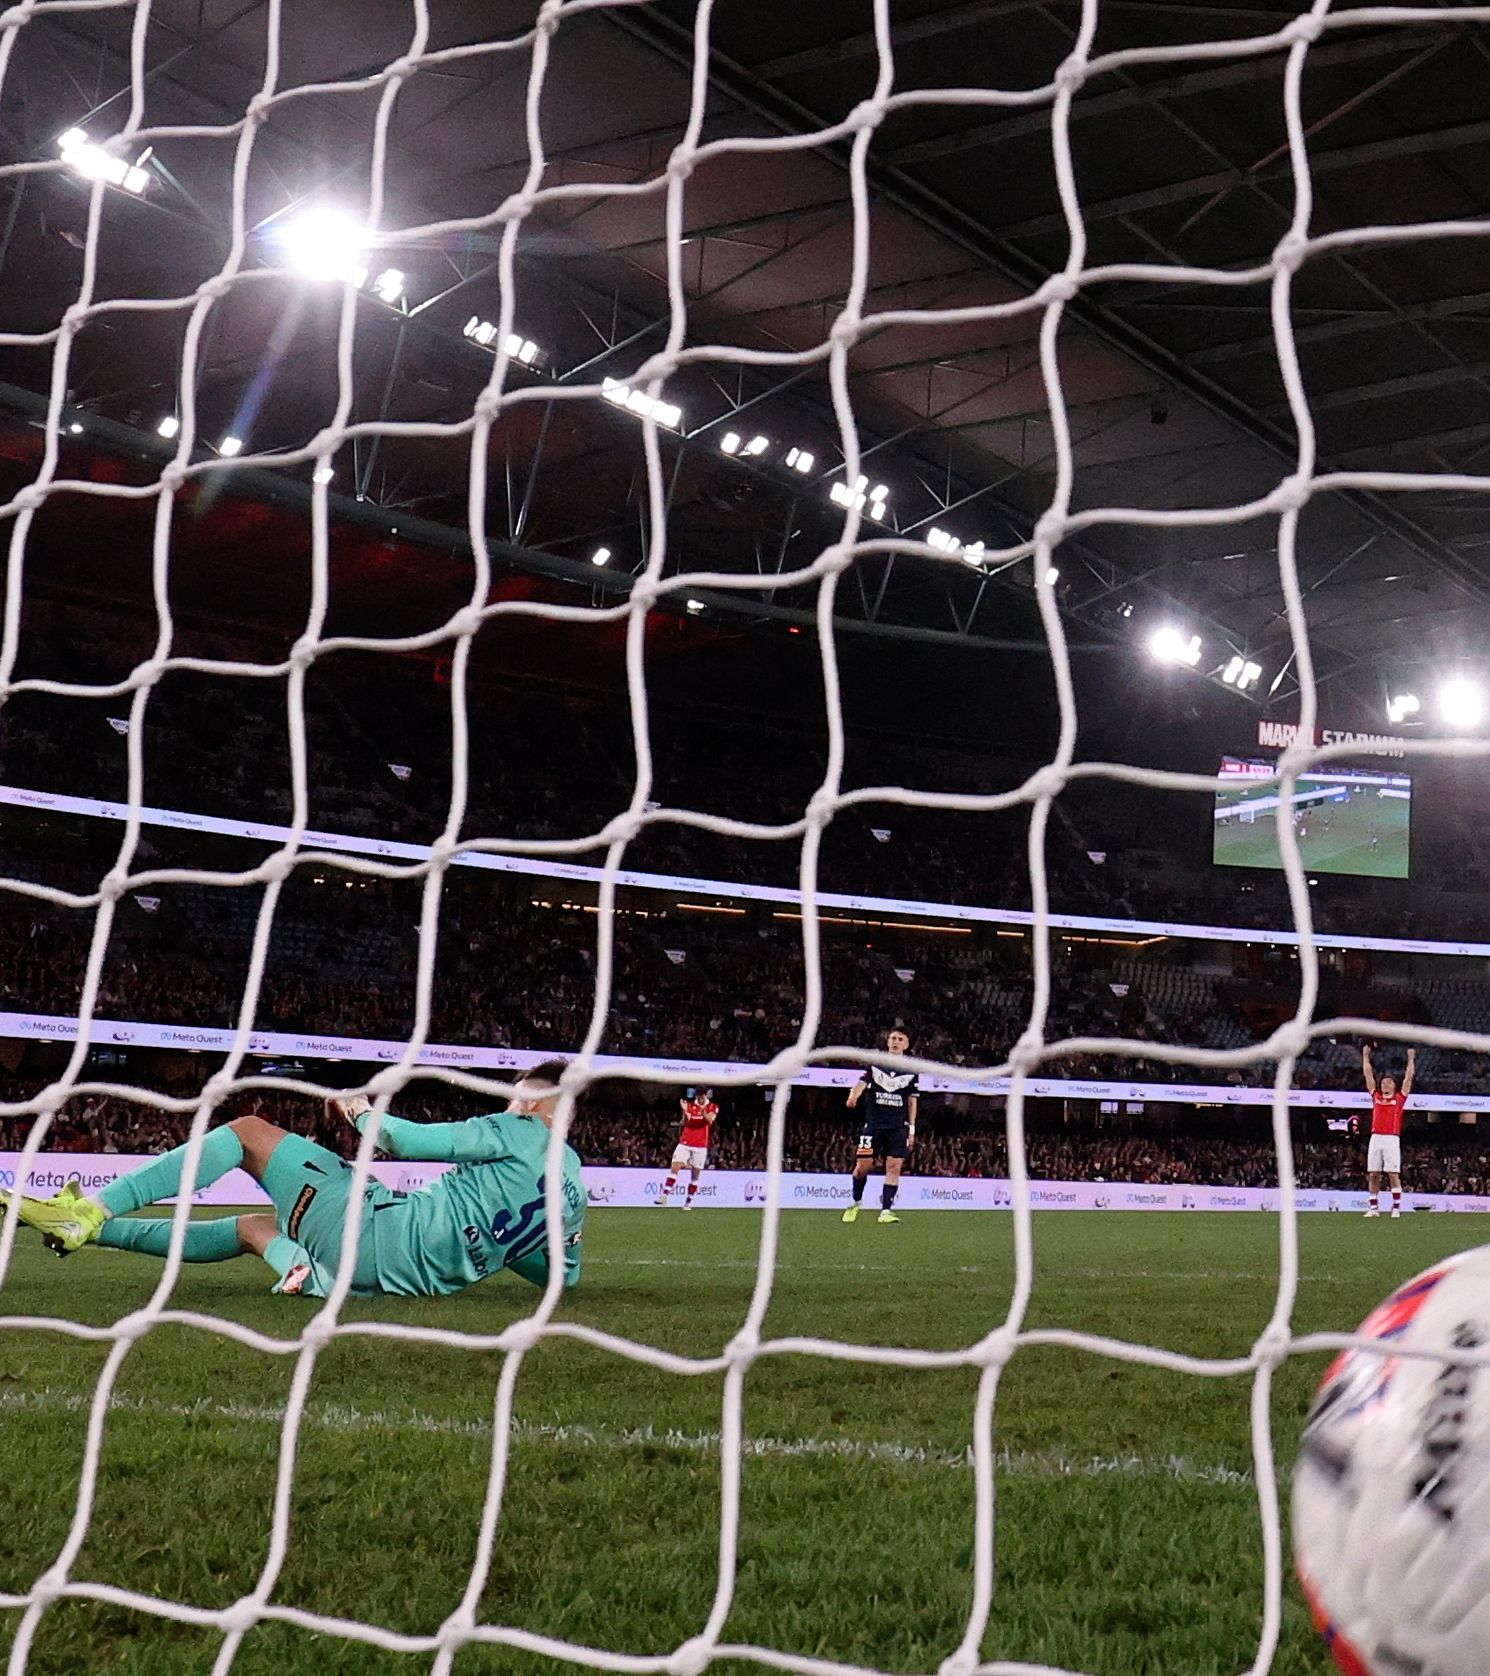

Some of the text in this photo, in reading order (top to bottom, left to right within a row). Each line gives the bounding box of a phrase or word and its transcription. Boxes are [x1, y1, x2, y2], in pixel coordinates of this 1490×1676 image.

[32, 1021, 56, 1032] Meta
[172, 1033, 222, 1044] Meta Quest
[306, 1041, 353, 1052] Meta Quest
[429, 1050, 475, 1061] Meta Quest
[805, 1186, 852, 1198] Meta Ques
[931, 1189, 974, 1201] Meta Quest
[1039, 1191, 1076, 1202] Meta Quest
